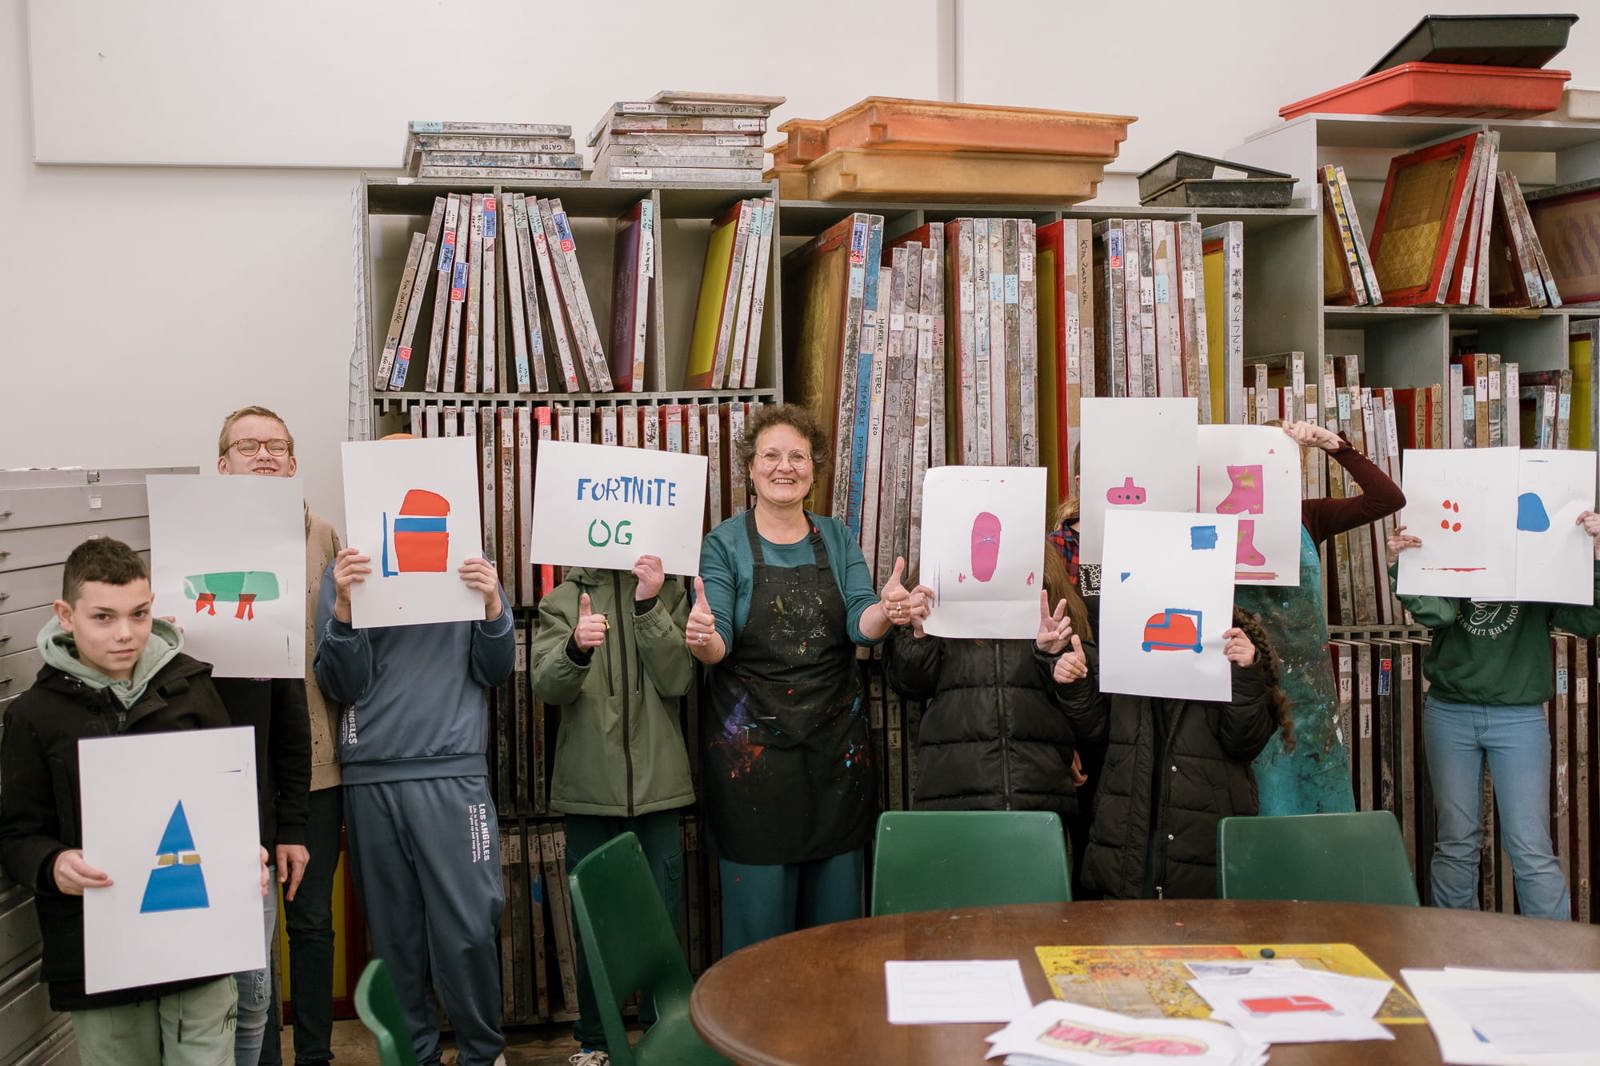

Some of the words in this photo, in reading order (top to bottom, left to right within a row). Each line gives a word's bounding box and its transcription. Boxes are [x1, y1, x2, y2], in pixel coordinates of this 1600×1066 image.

[588, 519, 632, 547] OG
[479, 803, 487, 820] LOS
[480, 821, 490, 861] ANGELES
